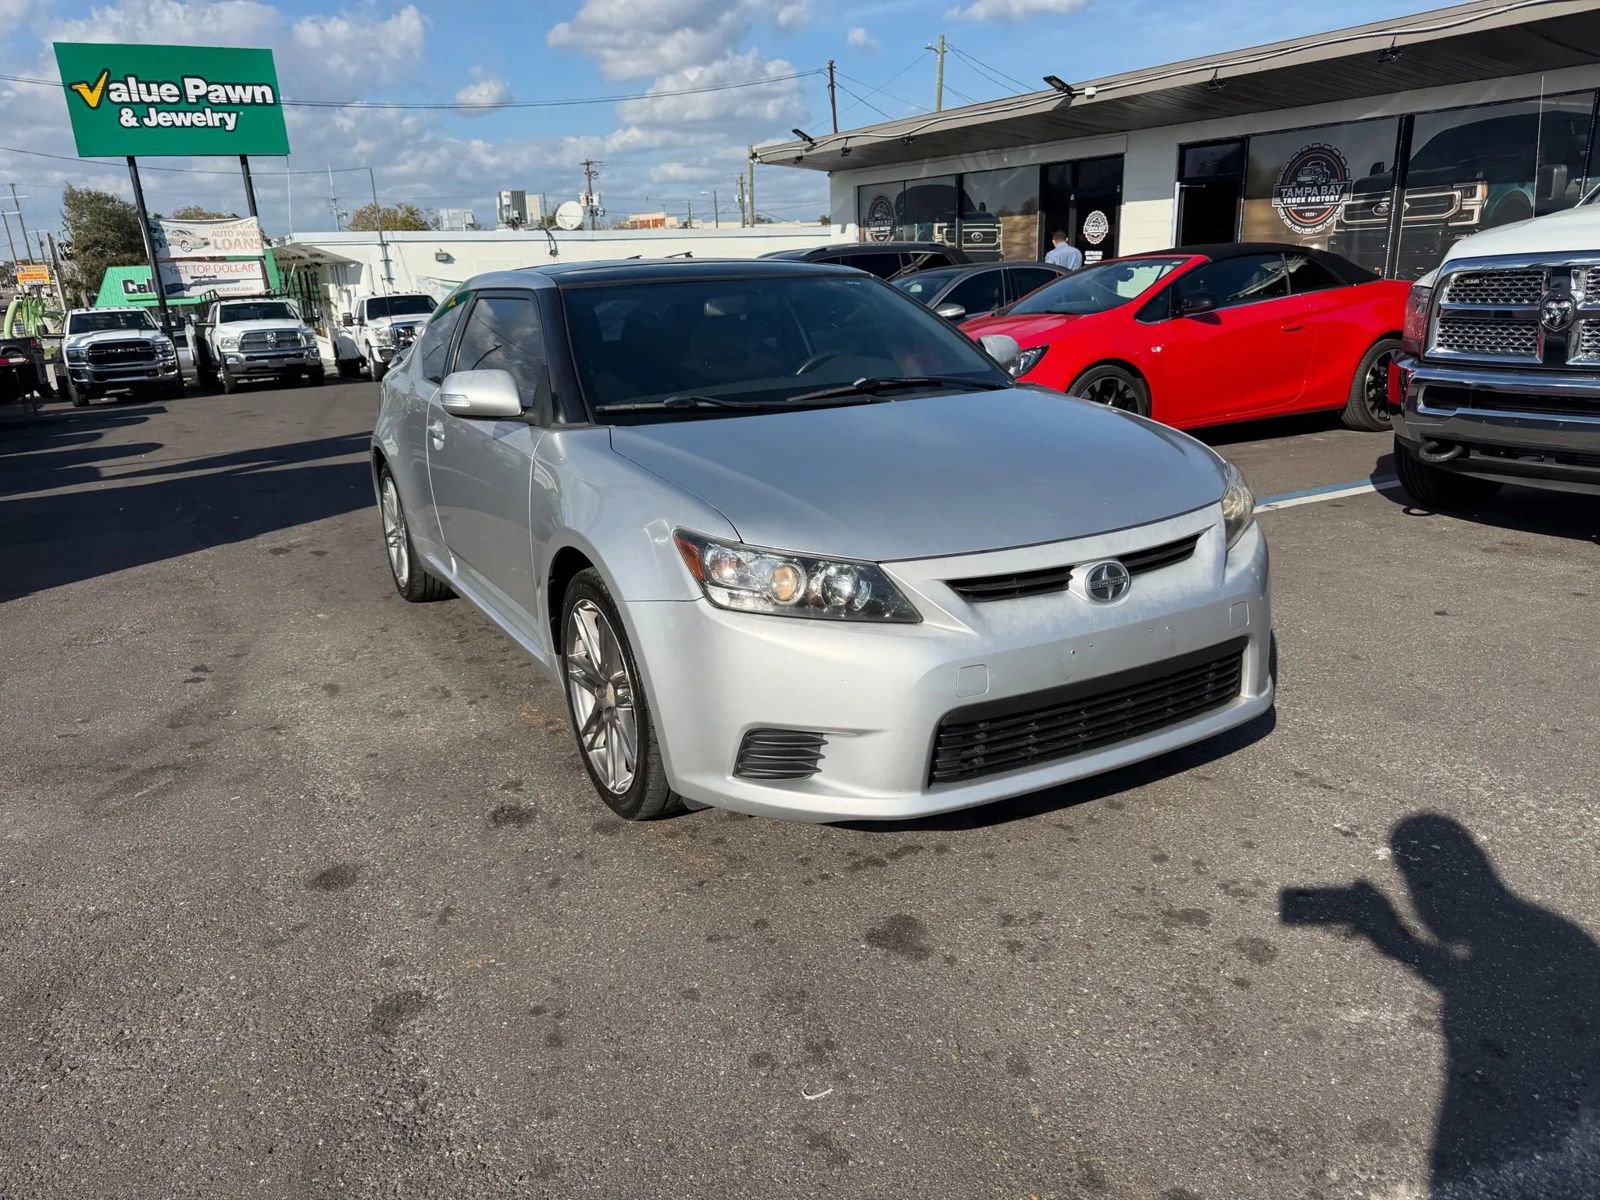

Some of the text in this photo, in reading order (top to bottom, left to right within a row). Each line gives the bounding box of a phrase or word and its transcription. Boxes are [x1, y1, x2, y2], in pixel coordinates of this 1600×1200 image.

[71, 71, 274, 108] Value Pawn
[120, 107, 237, 131] & Jewelry
[1281, 184, 1344, 198] TAMPA BAY
[1283, 195, 1340, 204] TRUCK FACTORY
[211, 230, 234, 238] AUTO
[213, 237, 262, 250] LOANS
[169, 263, 256, 275] GET TOP DOLLAR
